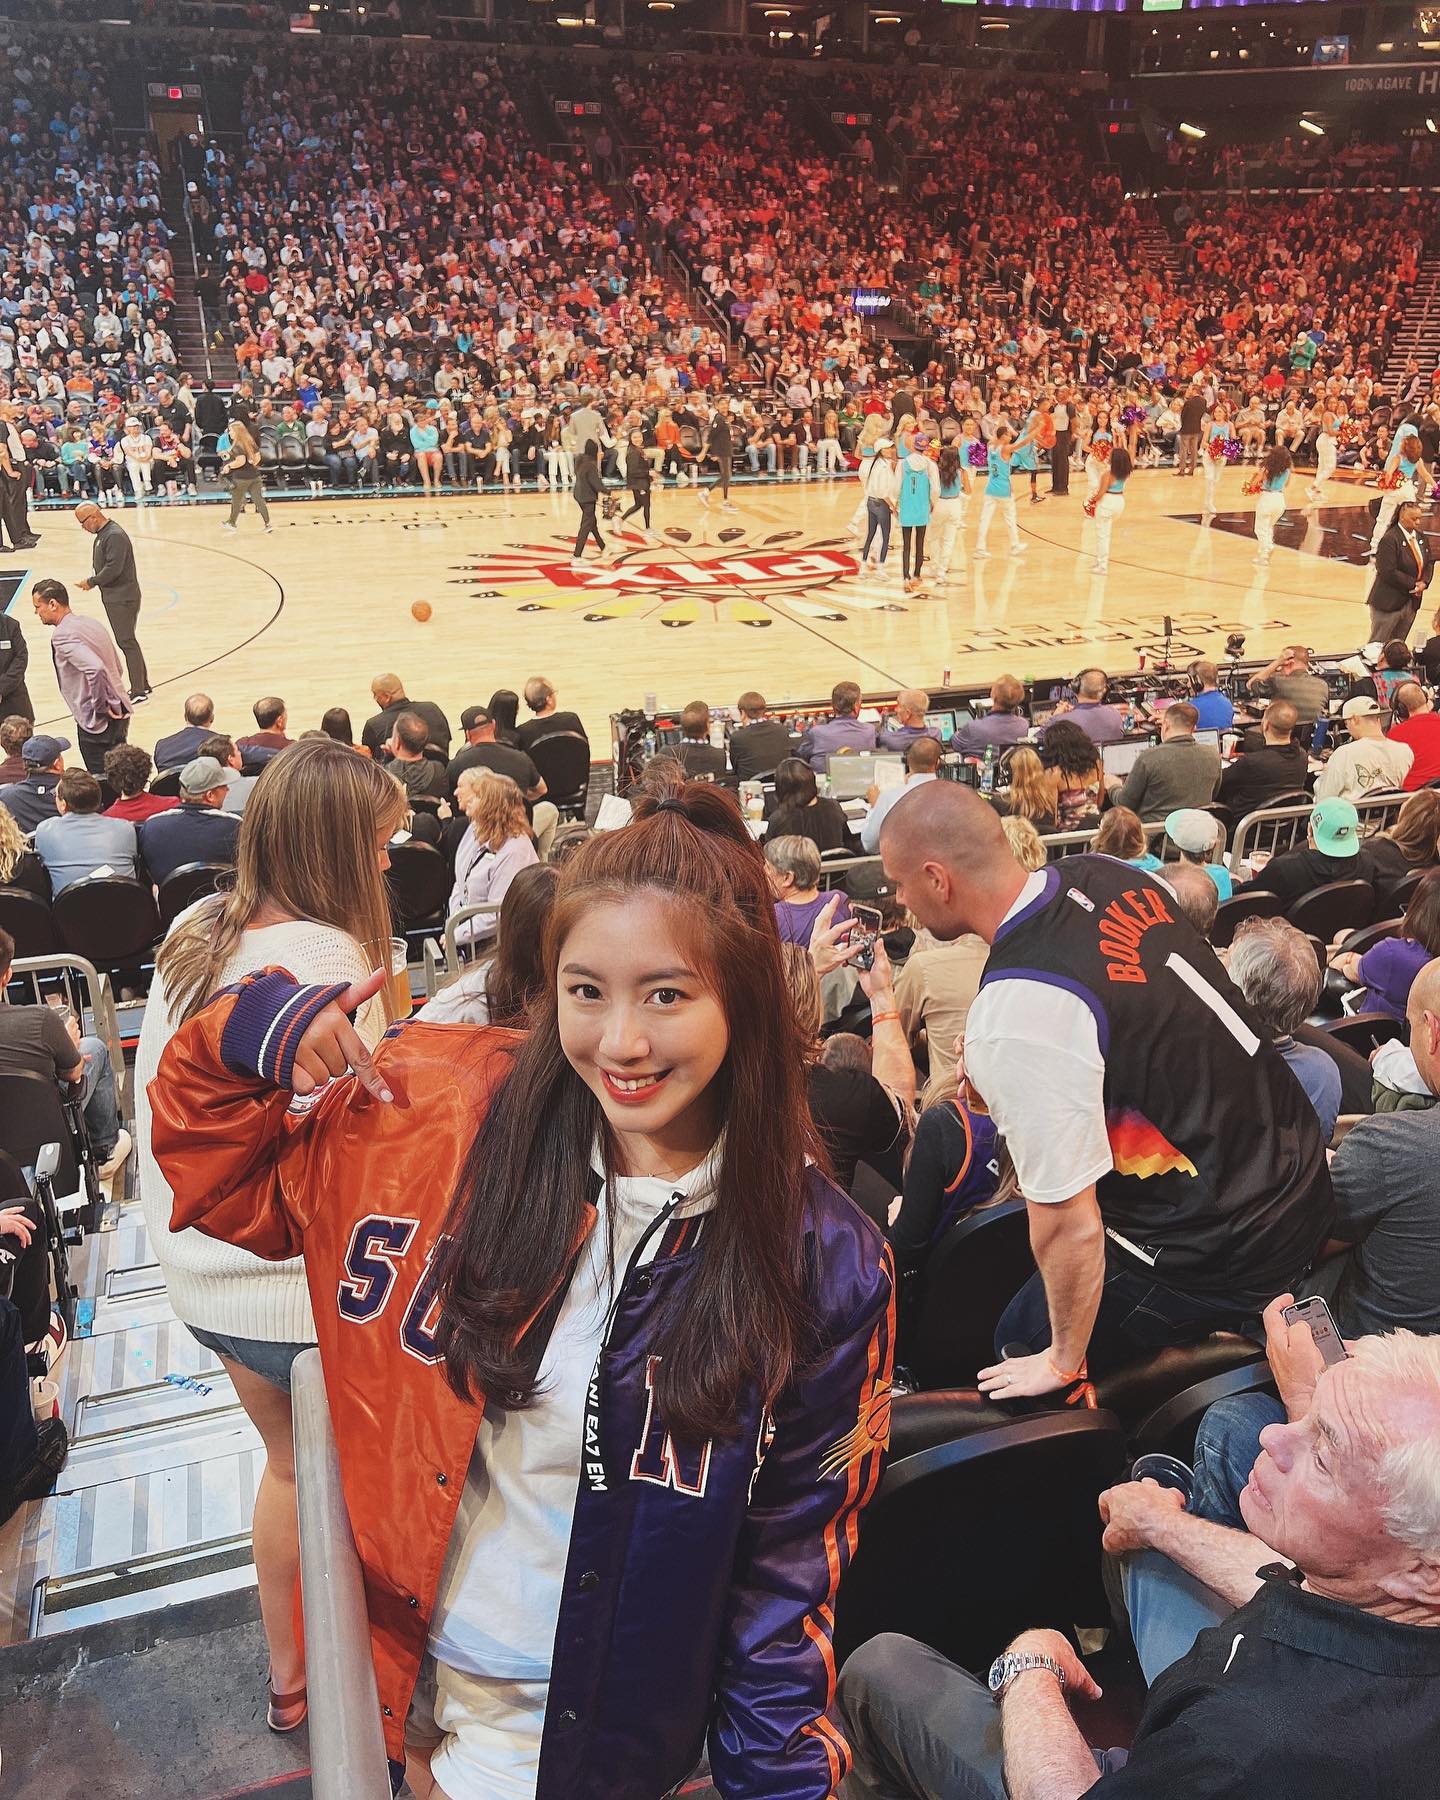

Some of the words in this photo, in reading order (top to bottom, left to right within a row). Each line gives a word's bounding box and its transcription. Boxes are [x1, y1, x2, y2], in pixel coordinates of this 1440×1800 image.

[1376, 76, 1412, 90] AGAVE
[1418, 71, 1440, 94] H
[555, 553, 857, 586] PHX
[957, 620, 1292, 654] FOOTPRINT
[1099, 888, 1175, 984] BOOKER
[1165, 952, 1261, 1057] 1
[585, 1413, 600, 1457] EA7
[586, 1462, 608, 1491] EM
